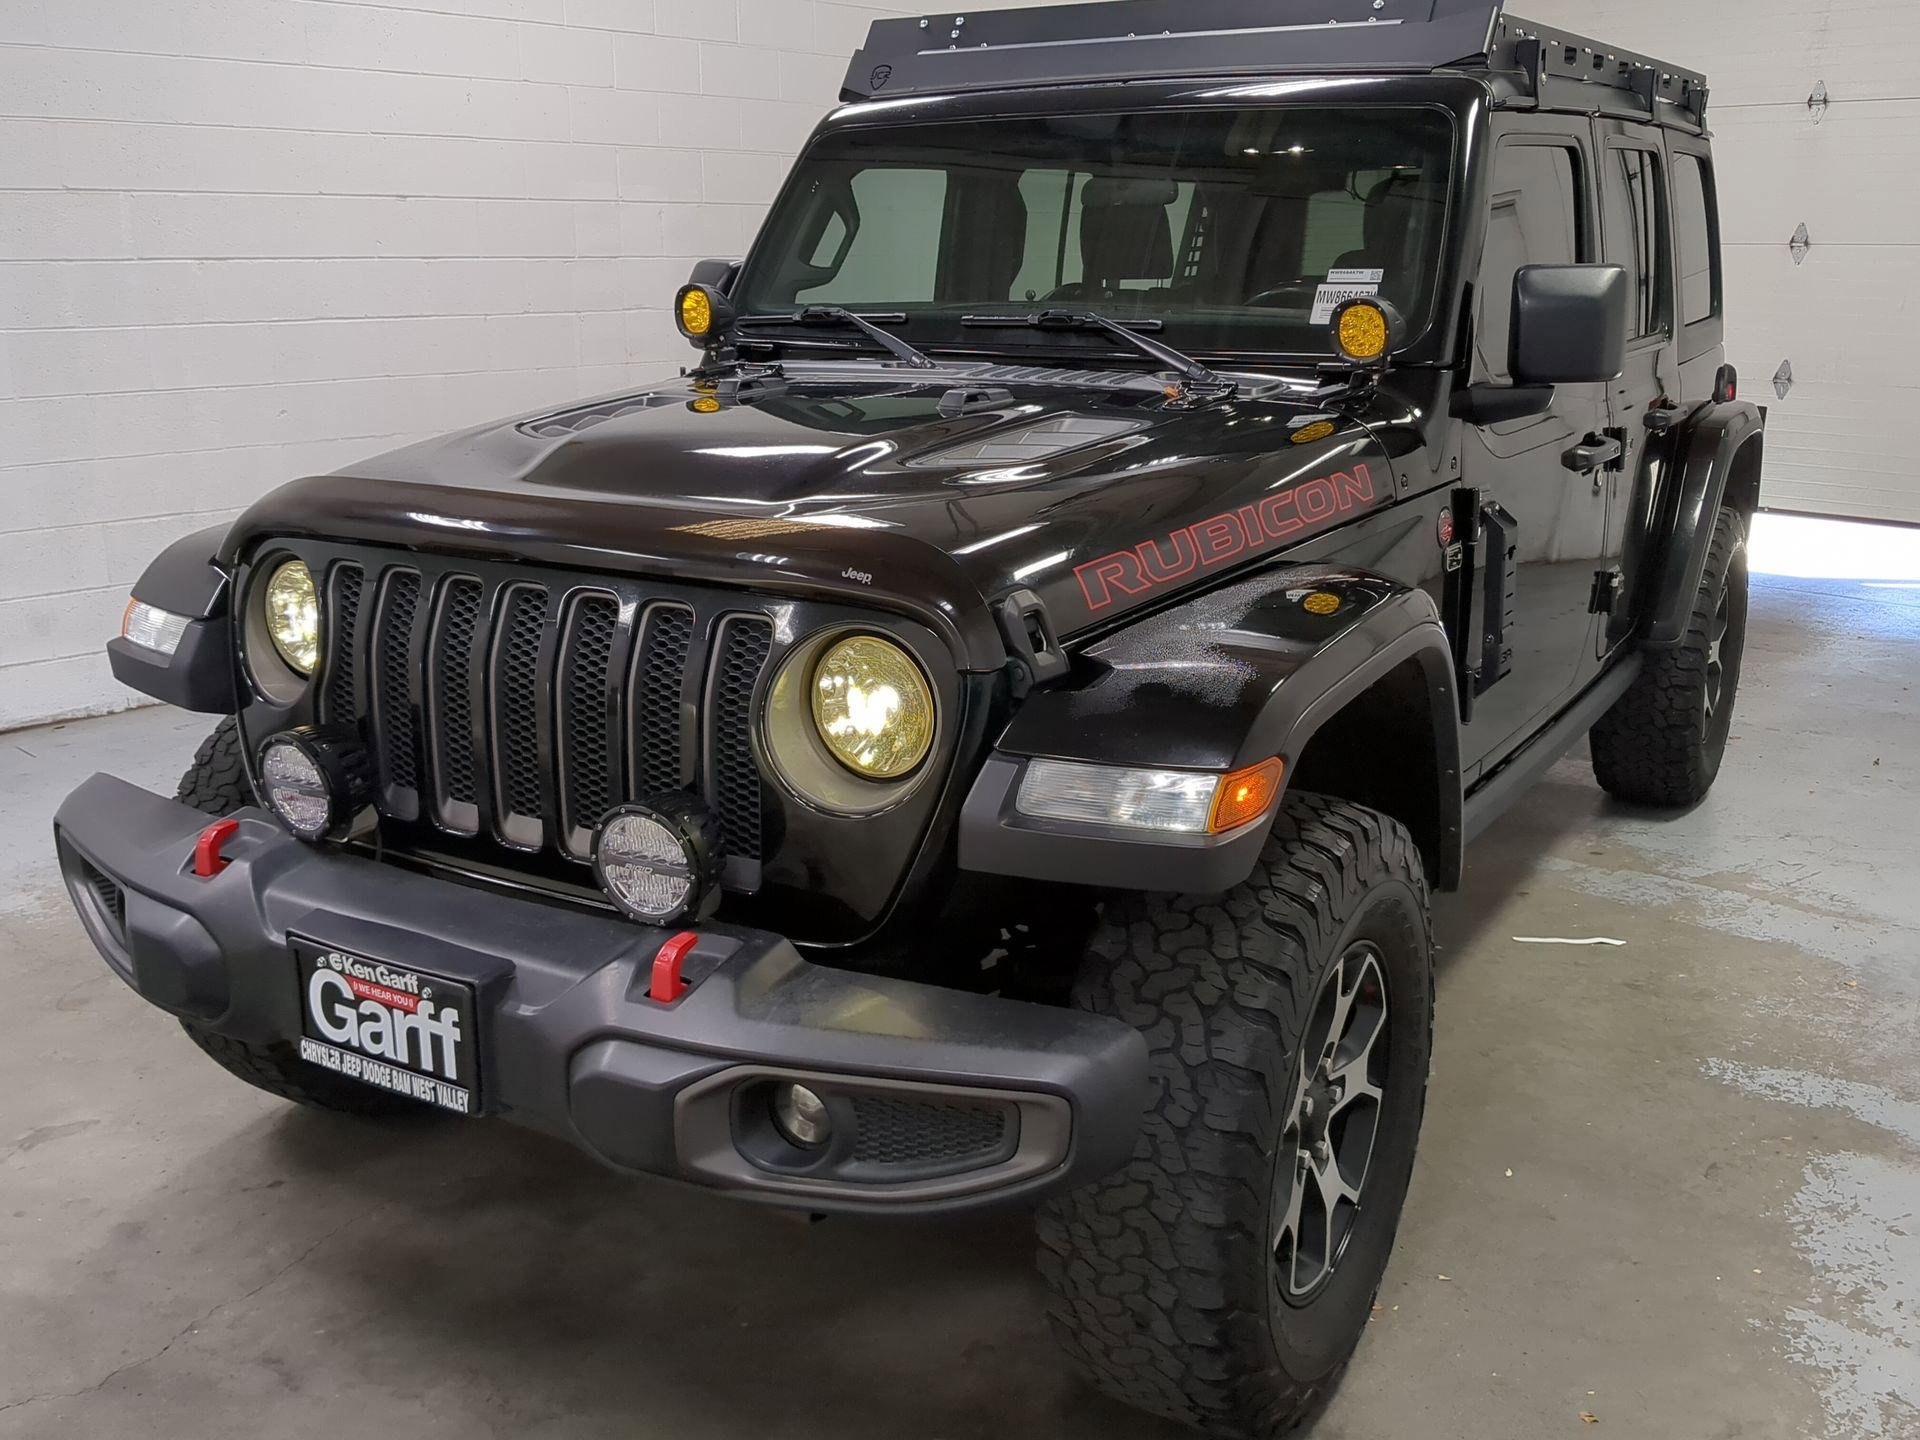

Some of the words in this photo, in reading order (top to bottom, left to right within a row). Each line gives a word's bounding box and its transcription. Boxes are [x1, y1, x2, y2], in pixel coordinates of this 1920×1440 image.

[1073, 464, 1374, 610] RUBICON
[841, 567, 873, 584] Jeep
[358, 983, 371, 994] WE
[371, 987, 392, 1000] HEAR
[392, 994, 408, 1006] YOU
[375, 965, 419, 994] Garff
[309, 968, 462, 1080] Garff
[301, 1039, 341, 1071] CHRYSLER
[342, 1053, 361, 1077] JEEP
[362, 1060, 391, 1088] DODGE
[392, 1069, 411, 1095] RAM
[411, 1075, 435, 1102] WEST
[436, 1083, 469, 1113] VALLEY
